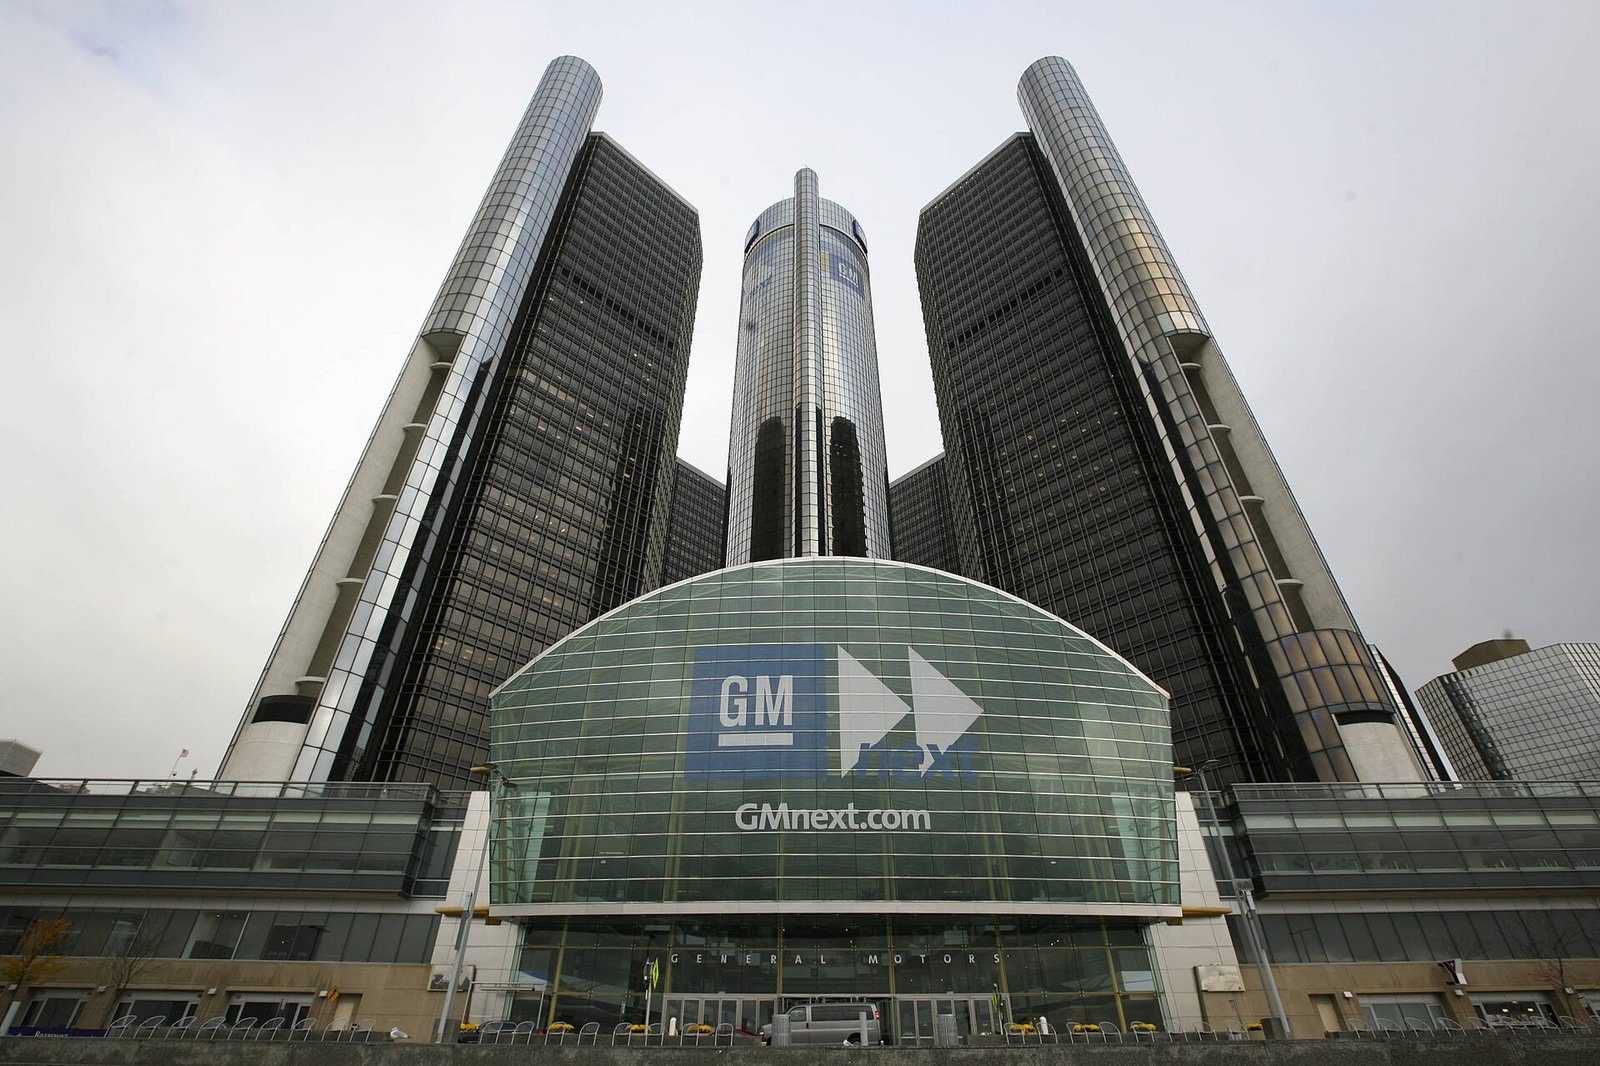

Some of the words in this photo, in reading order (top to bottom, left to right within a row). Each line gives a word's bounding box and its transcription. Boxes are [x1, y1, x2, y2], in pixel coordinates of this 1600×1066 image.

[838, 262, 859, 285] GM
[721, 675, 793, 727] GM
[854, 735, 980, 781] next
[735, 802, 931, 830] GMnext.com
[670, 953, 827, 964] GENERAL
[868, 953, 1001, 964] MOTORS
